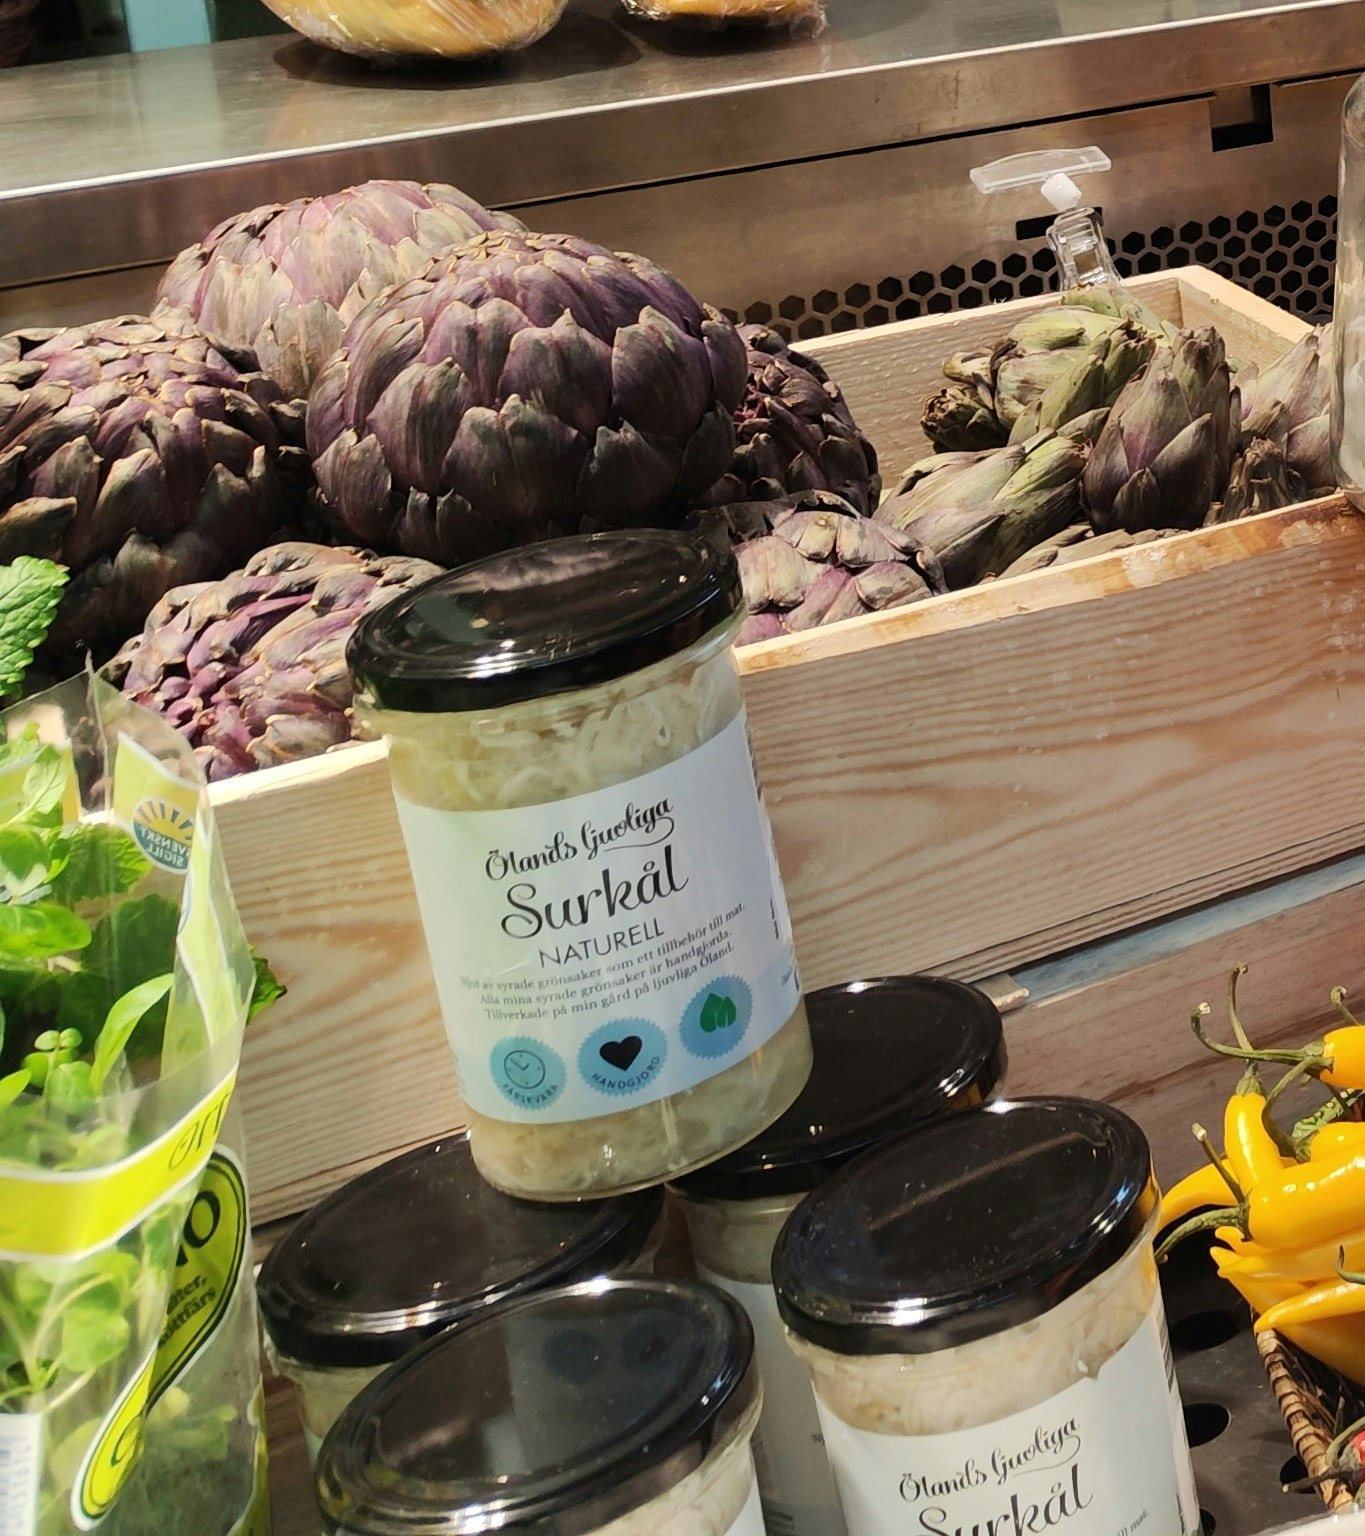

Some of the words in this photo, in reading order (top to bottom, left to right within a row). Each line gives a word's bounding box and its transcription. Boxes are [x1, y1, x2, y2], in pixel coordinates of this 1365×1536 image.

[484, 830, 578, 881] Ölands
[500, 843, 690, 940] Surkål
[503, 994, 532, 1005] mina
[535, 987, 577, 1006] syrade
[580, 972, 646, 998] grönsaker
[665, 930, 733, 968] handgjorda.
[538, 917, 666, 968] NATURELL
[538, 967, 602, 991] grönsaker
[605, 959, 634, 974] som
[637, 951, 654, 965] ett
[657, 927, 708, 957] tillbehör
[709, 915, 725, 932] till
[725, 903, 746, 923] mat.
[484, 1007, 550, 1021] Tillverkade
[552, 1004, 568, 1020] på
[571, 999, 598, 1015] min
[600, 990, 631, 1010] gård
[634, 983, 651, 1001] på
[653, 963, 698, 991] ljuvliga
[699, 941, 735, 969] Öland.
[591, 1055, 661, 1090] HANDGJORD
[899, 1458, 988, 1503] Ölands
